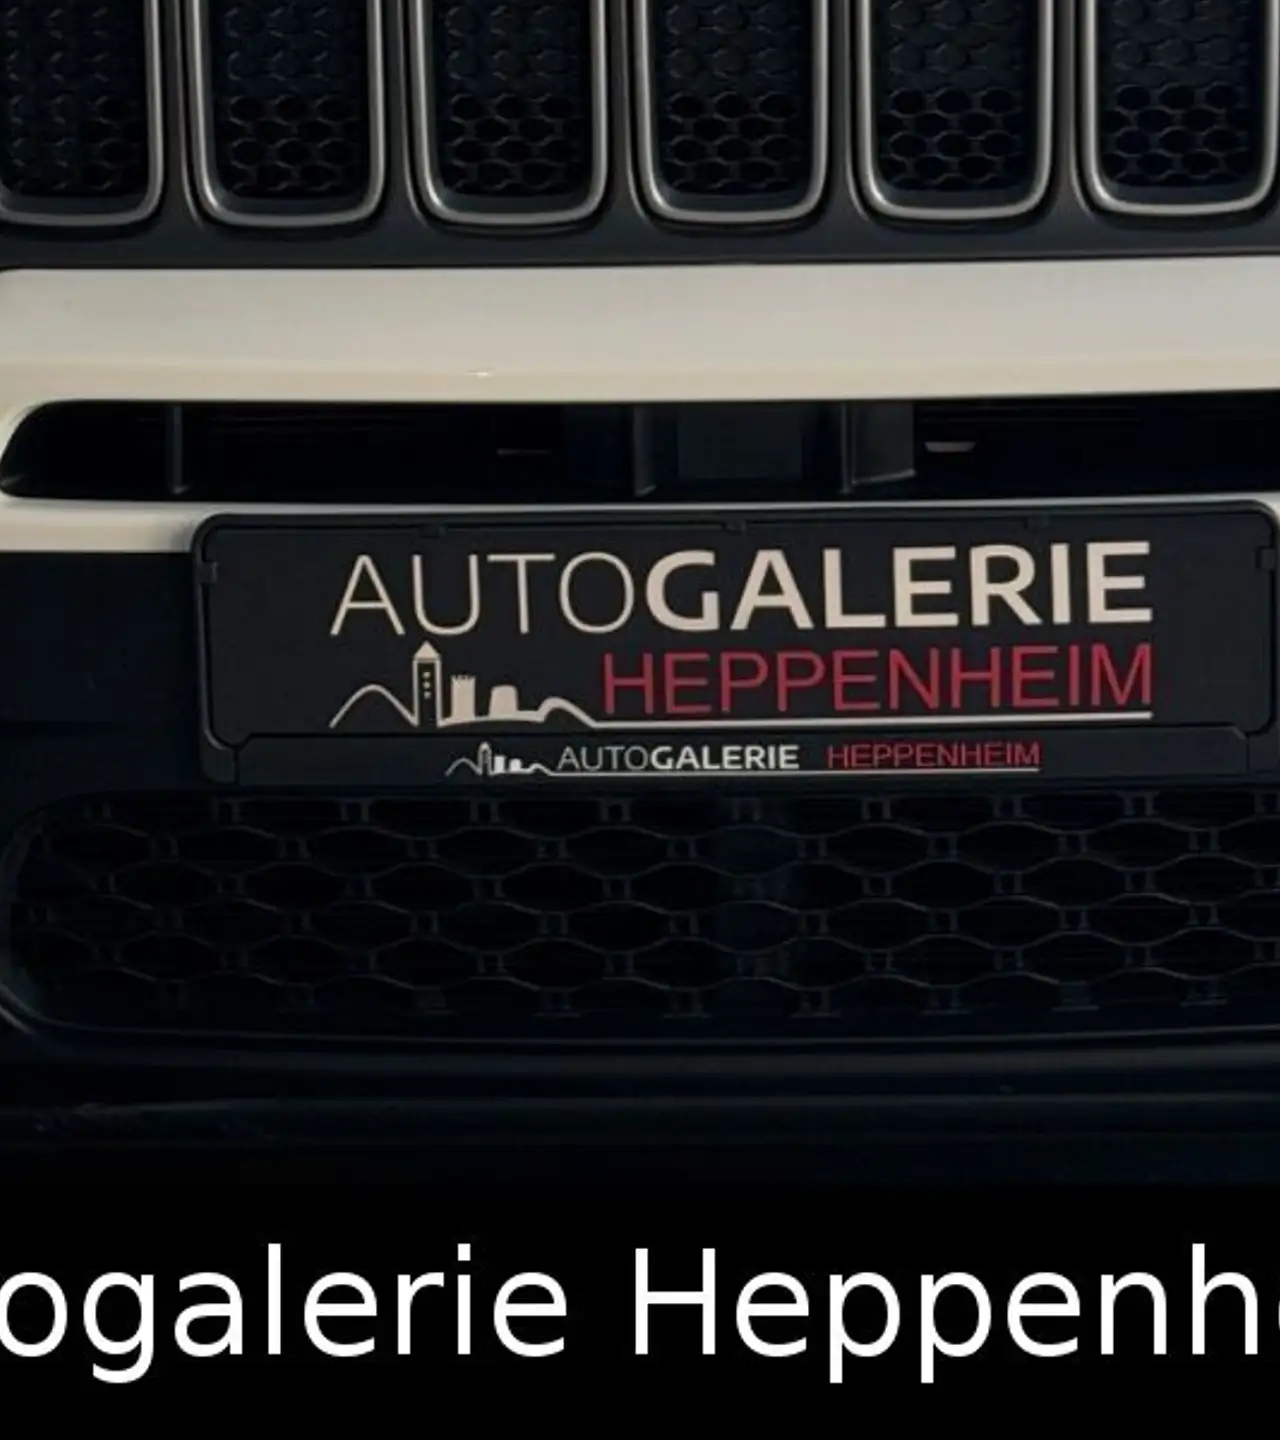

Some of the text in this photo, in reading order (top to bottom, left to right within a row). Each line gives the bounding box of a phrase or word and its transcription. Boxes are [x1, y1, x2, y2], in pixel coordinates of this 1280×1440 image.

[330, 541, 1153, 636] AUTOGALERIE
[602, 642, 1153, 716] HEPPENHEIM
[557, 741, 1041, 771] AUTOGALERIE HEPPENHEIM
